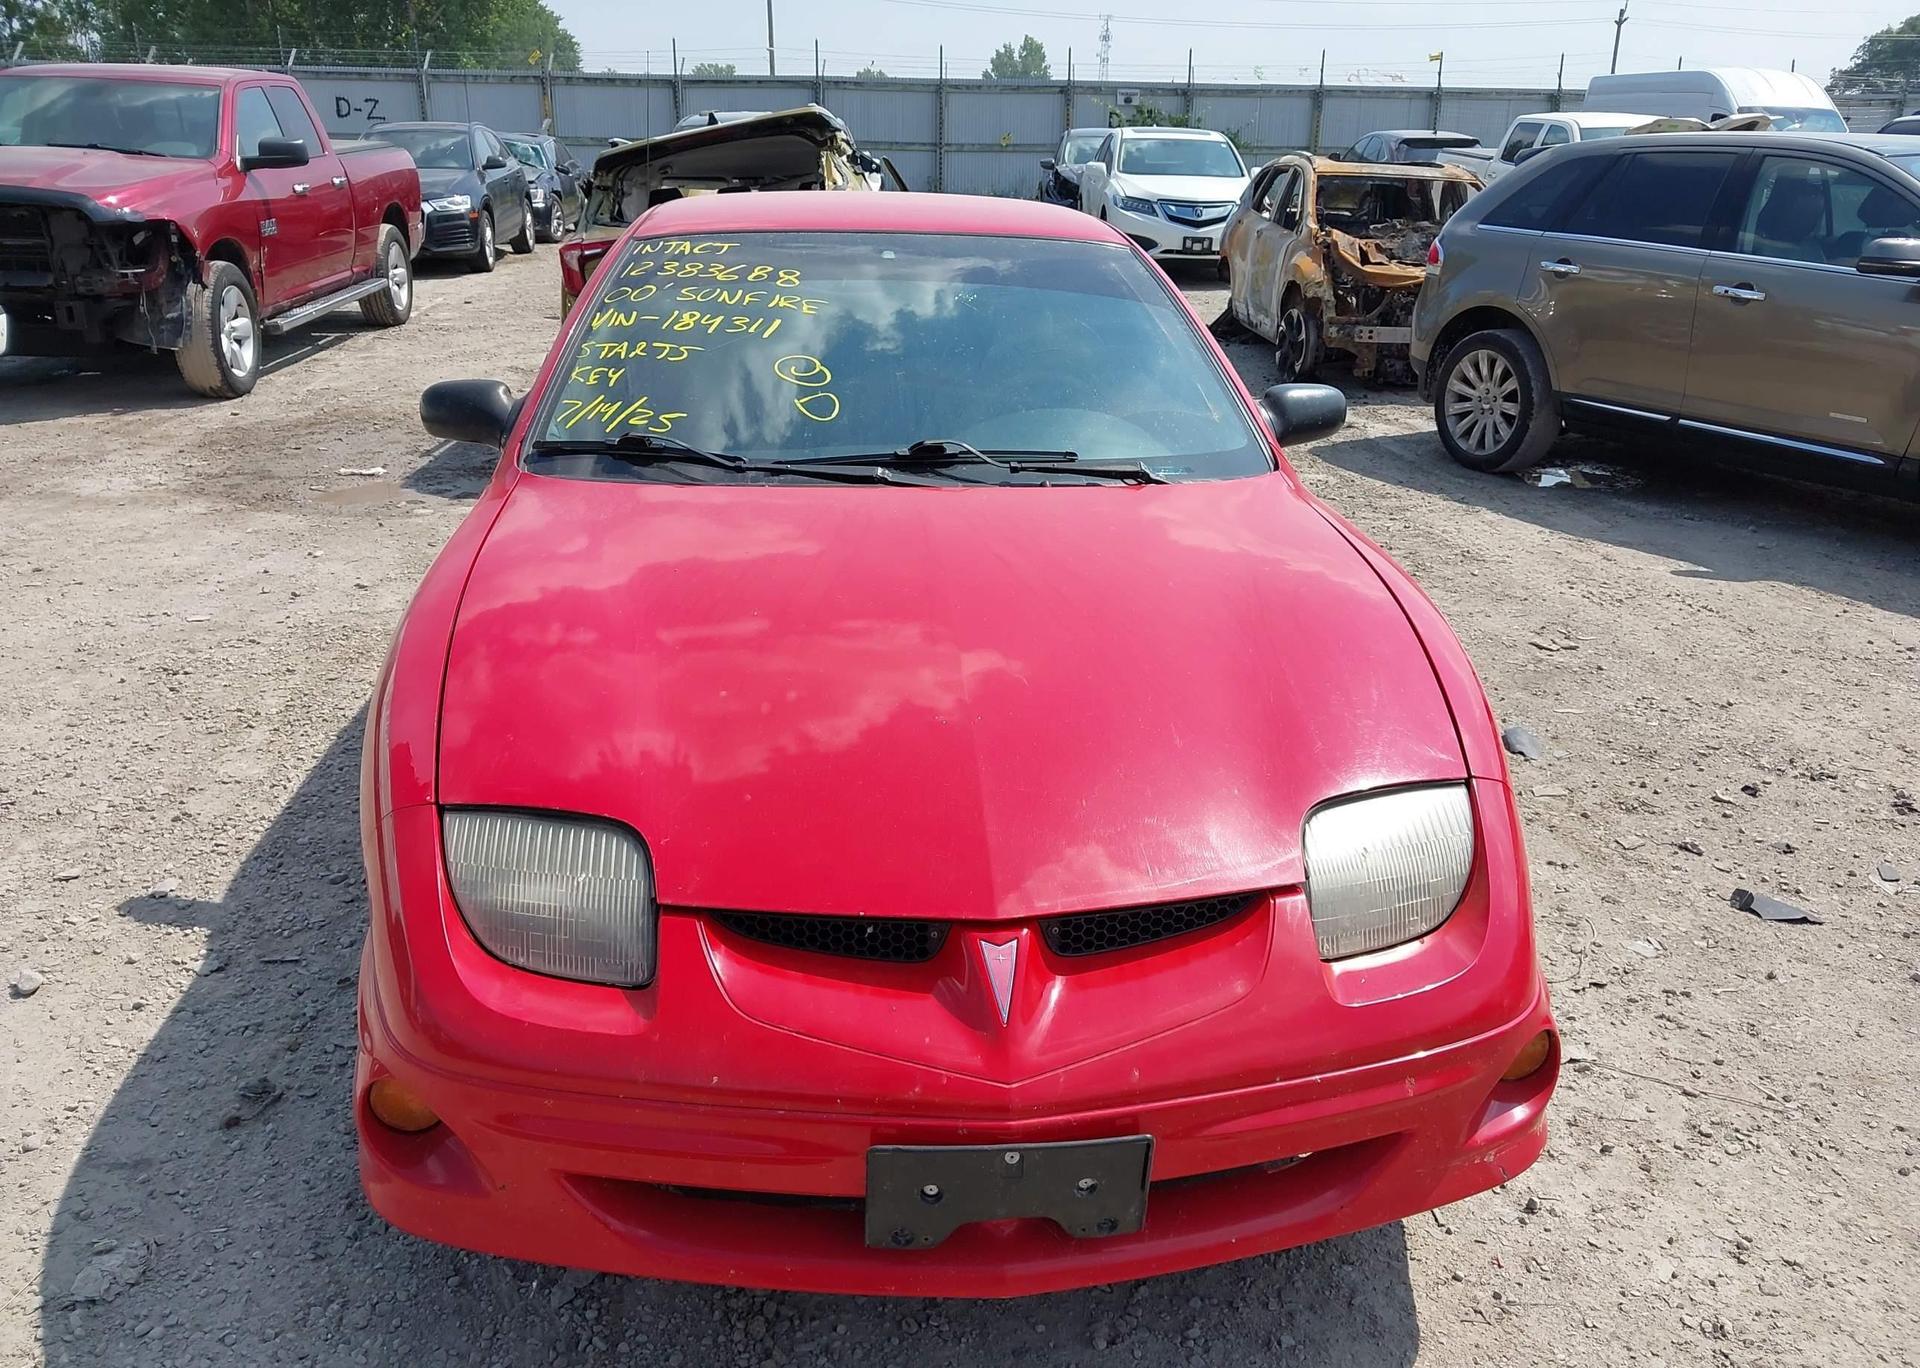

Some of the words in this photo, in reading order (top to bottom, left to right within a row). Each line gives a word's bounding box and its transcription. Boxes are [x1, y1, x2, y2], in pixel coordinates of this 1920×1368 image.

[335, 96, 386, 120] D-Z
[633, 240, 741, 255] INTACT
[620, 261, 801, 287] 12383688
[675, 286, 829, 315] SUNFIRE
[576, 341, 705, 361] STARTS
[568, 366, 626, 387] KEY
[556, 394, 688, 433] 7/14/25
